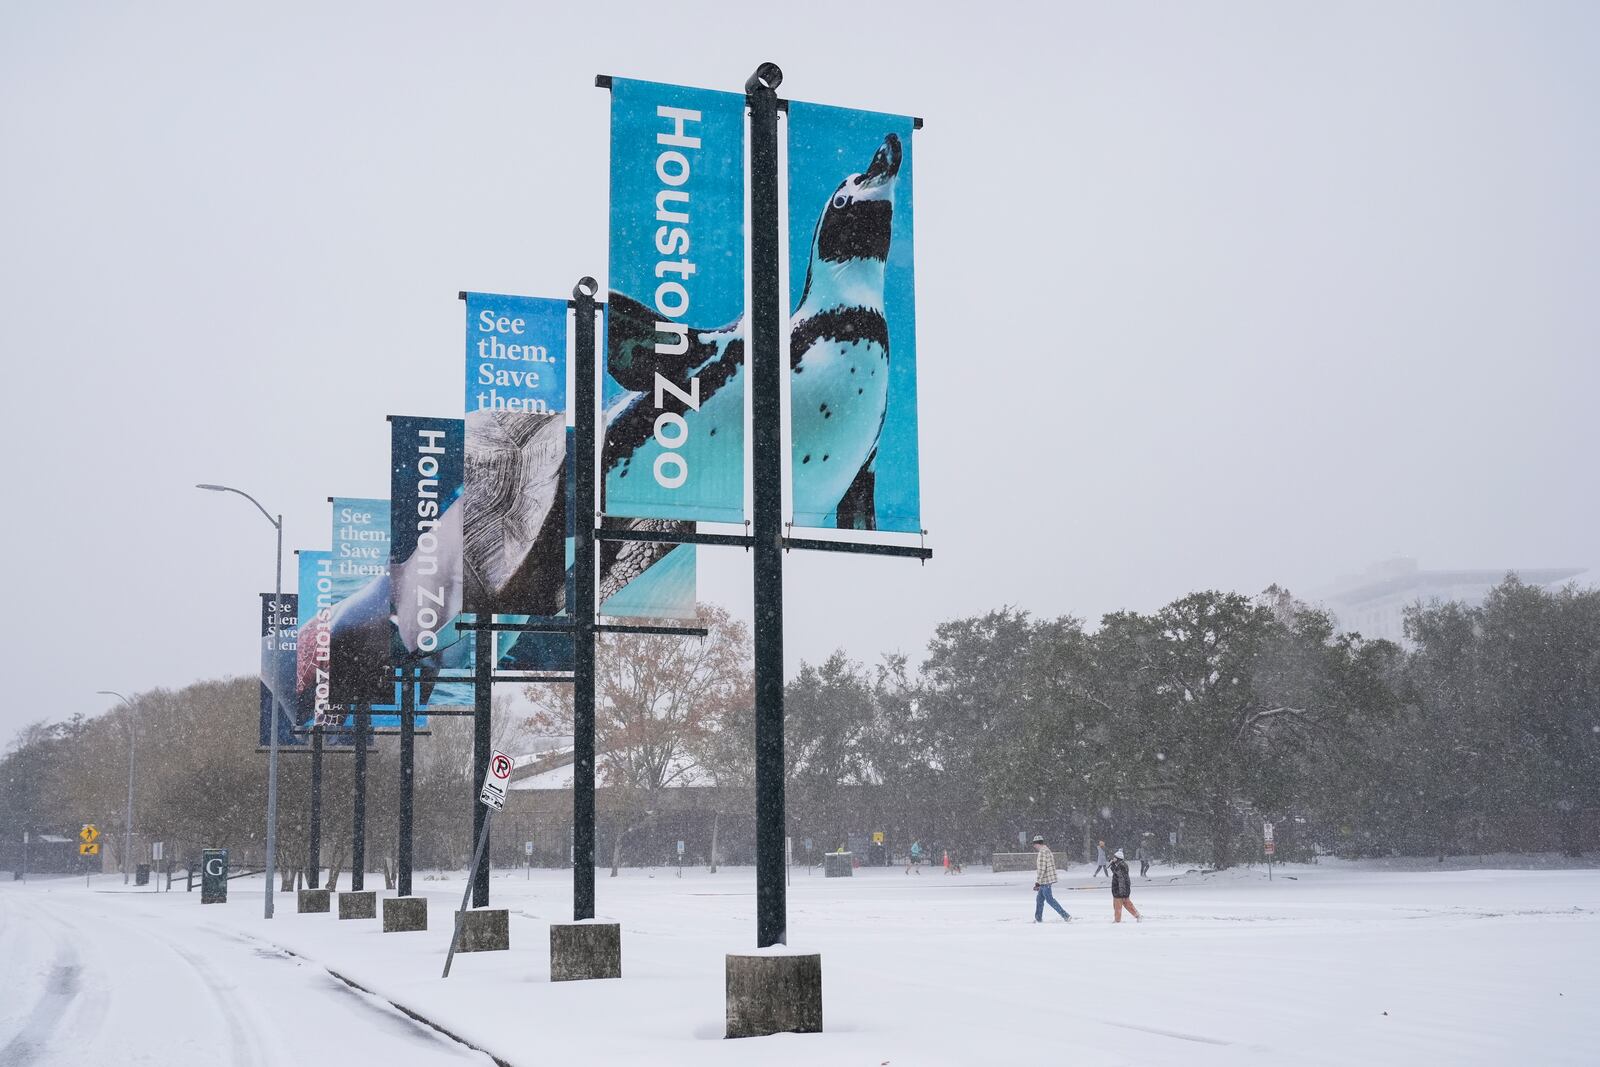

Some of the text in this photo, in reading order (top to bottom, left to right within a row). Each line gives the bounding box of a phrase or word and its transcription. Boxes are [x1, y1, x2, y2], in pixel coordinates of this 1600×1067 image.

[653, 104, 703, 490] Houston Zoo
[478, 310, 526, 335] See
[477, 334, 556, 364] them.
[478, 363, 540, 389] Save
[477, 389, 556, 415] them.
[340, 508, 372, 524] See
[339, 525, 391, 542] them.
[416, 429, 446, 653] Houston Zoo
[340, 542, 381, 559] Save
[339, 559, 391, 577] them.
[206, 858, 223, 876] G
